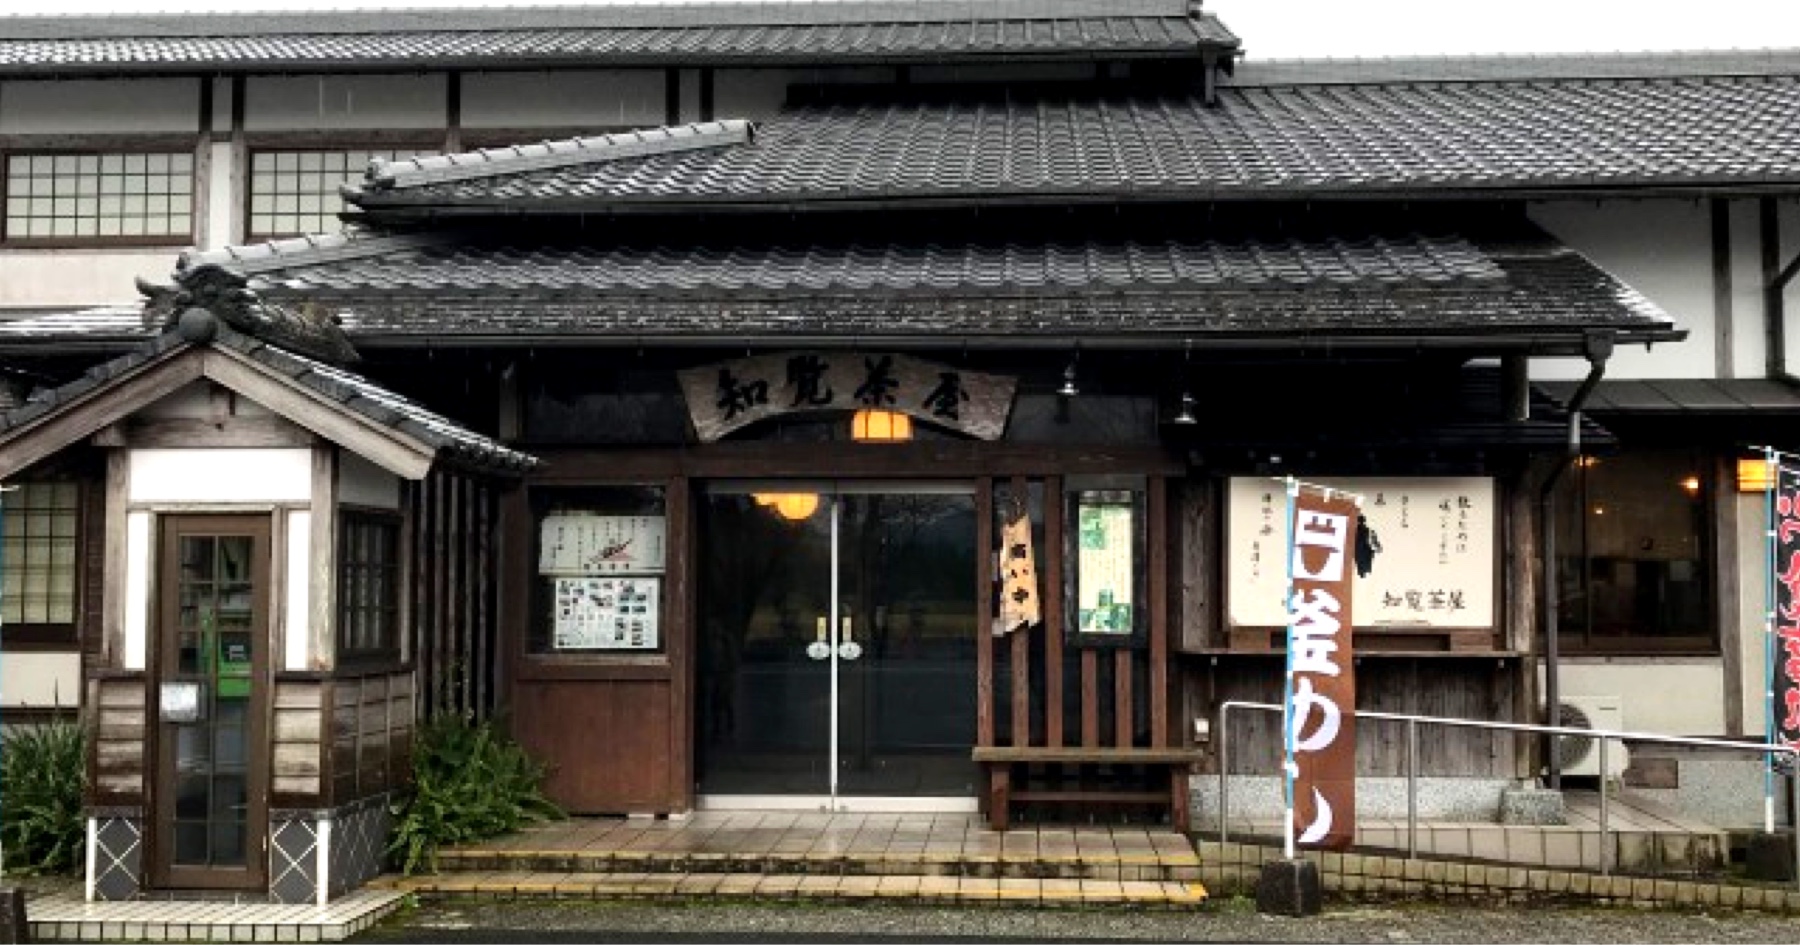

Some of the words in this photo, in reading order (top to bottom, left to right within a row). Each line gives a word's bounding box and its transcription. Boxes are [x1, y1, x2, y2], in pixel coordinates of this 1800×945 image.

[715, 354, 969, 421] 知覧茶屋
[1382, 588, 1466, 612] 知覧茶屋
